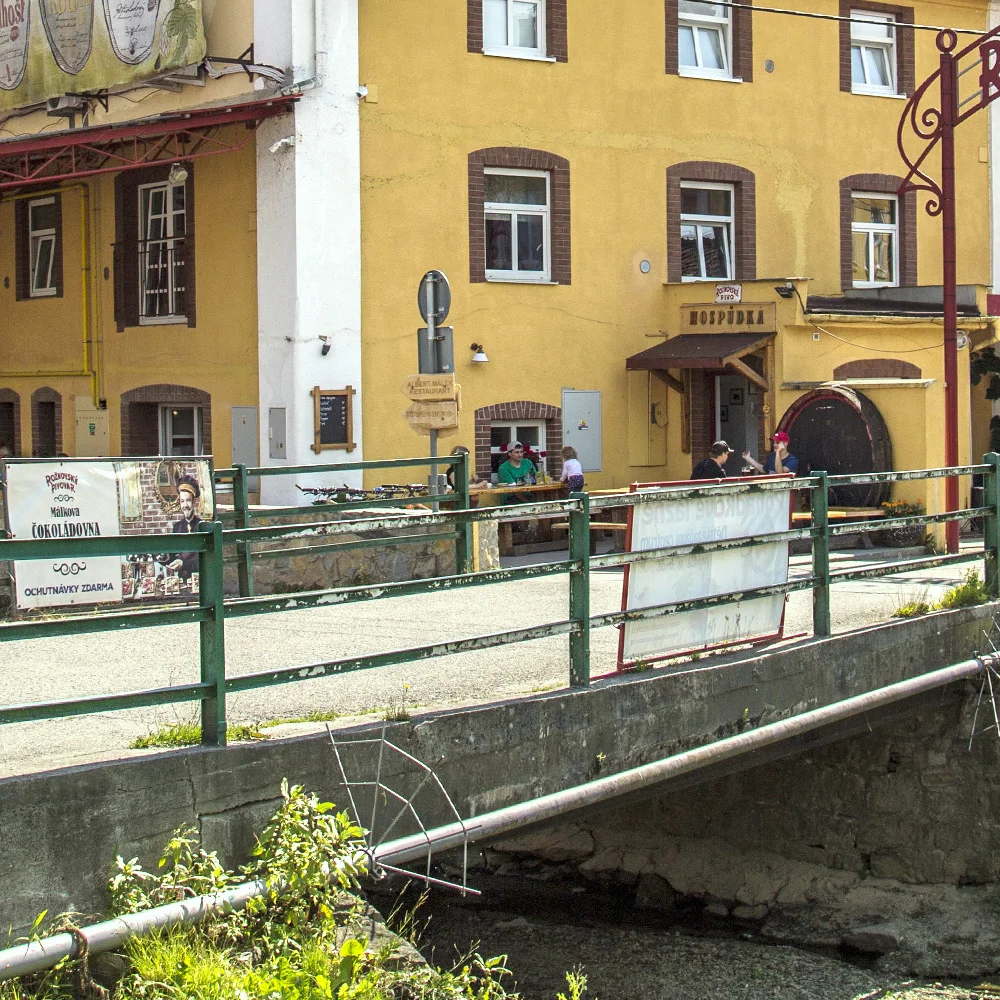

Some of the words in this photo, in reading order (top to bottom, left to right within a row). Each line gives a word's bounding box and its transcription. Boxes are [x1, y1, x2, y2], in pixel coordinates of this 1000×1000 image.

[410, 387, 451, 395] RESTAURANT
[45, 471, 79, 487] ROŽNOVSKÝ
[51, 482, 76, 493] PIVOVAR
[50, 505, 80, 518] Málkova
[31, 520, 101, 539] ČOKOLÁDOVNA
[24, 583, 79, 597] OCHUTNÁVKY
[81, 582, 114, 593] ZDARMA
